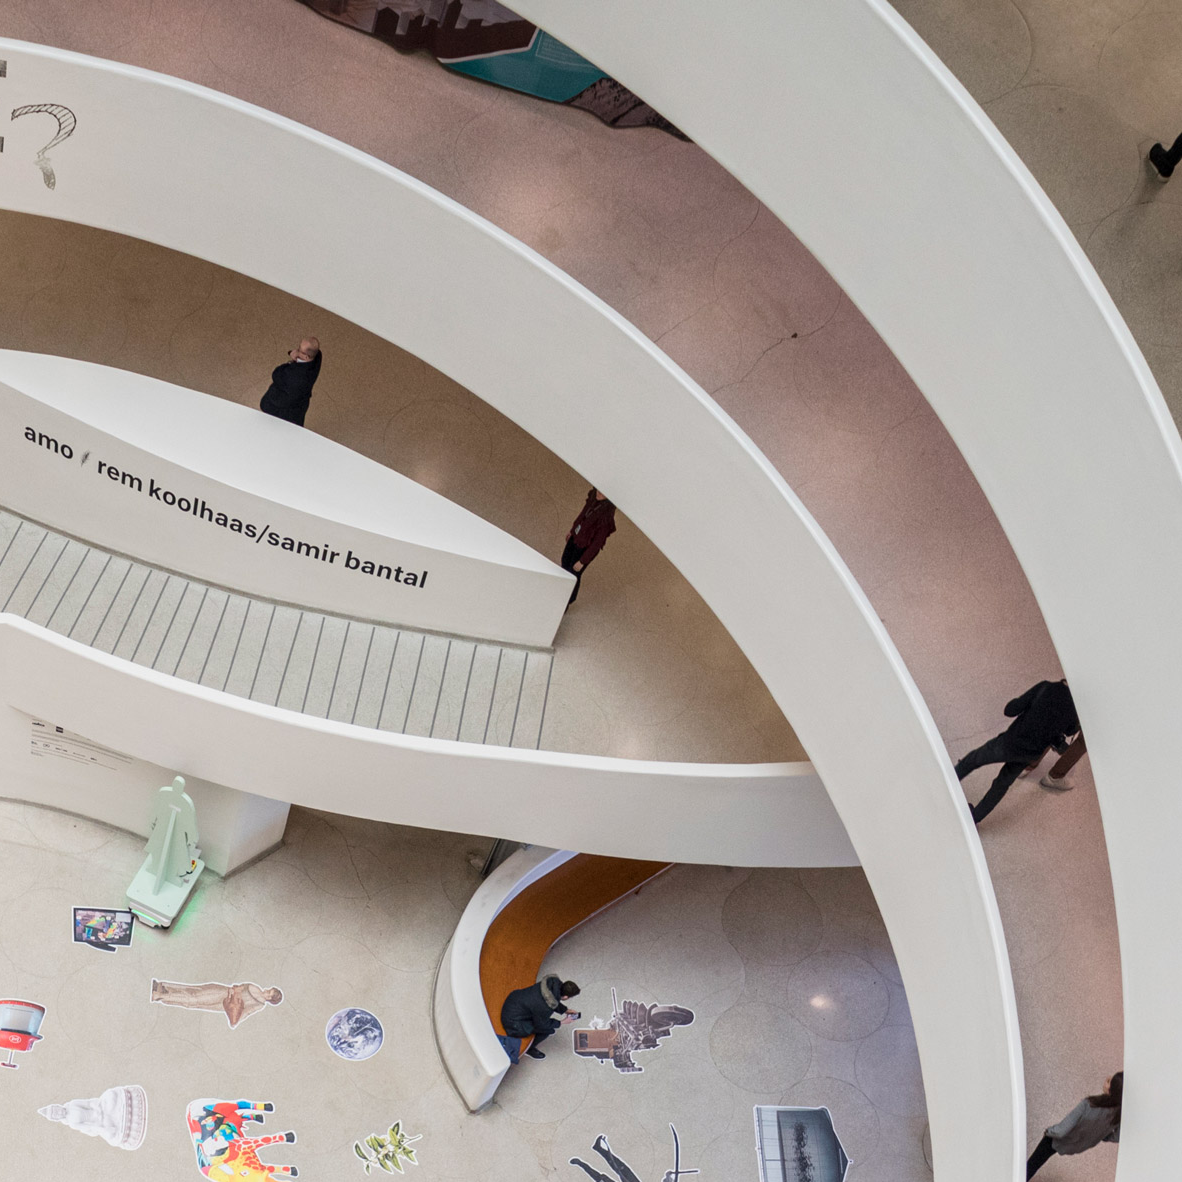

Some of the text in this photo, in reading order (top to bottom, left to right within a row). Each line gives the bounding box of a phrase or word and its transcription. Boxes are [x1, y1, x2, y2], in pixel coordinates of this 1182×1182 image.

[24, 426, 74, 460] amo
[97, 459, 144, 491] rem
[344, 550, 429, 589] bantal
